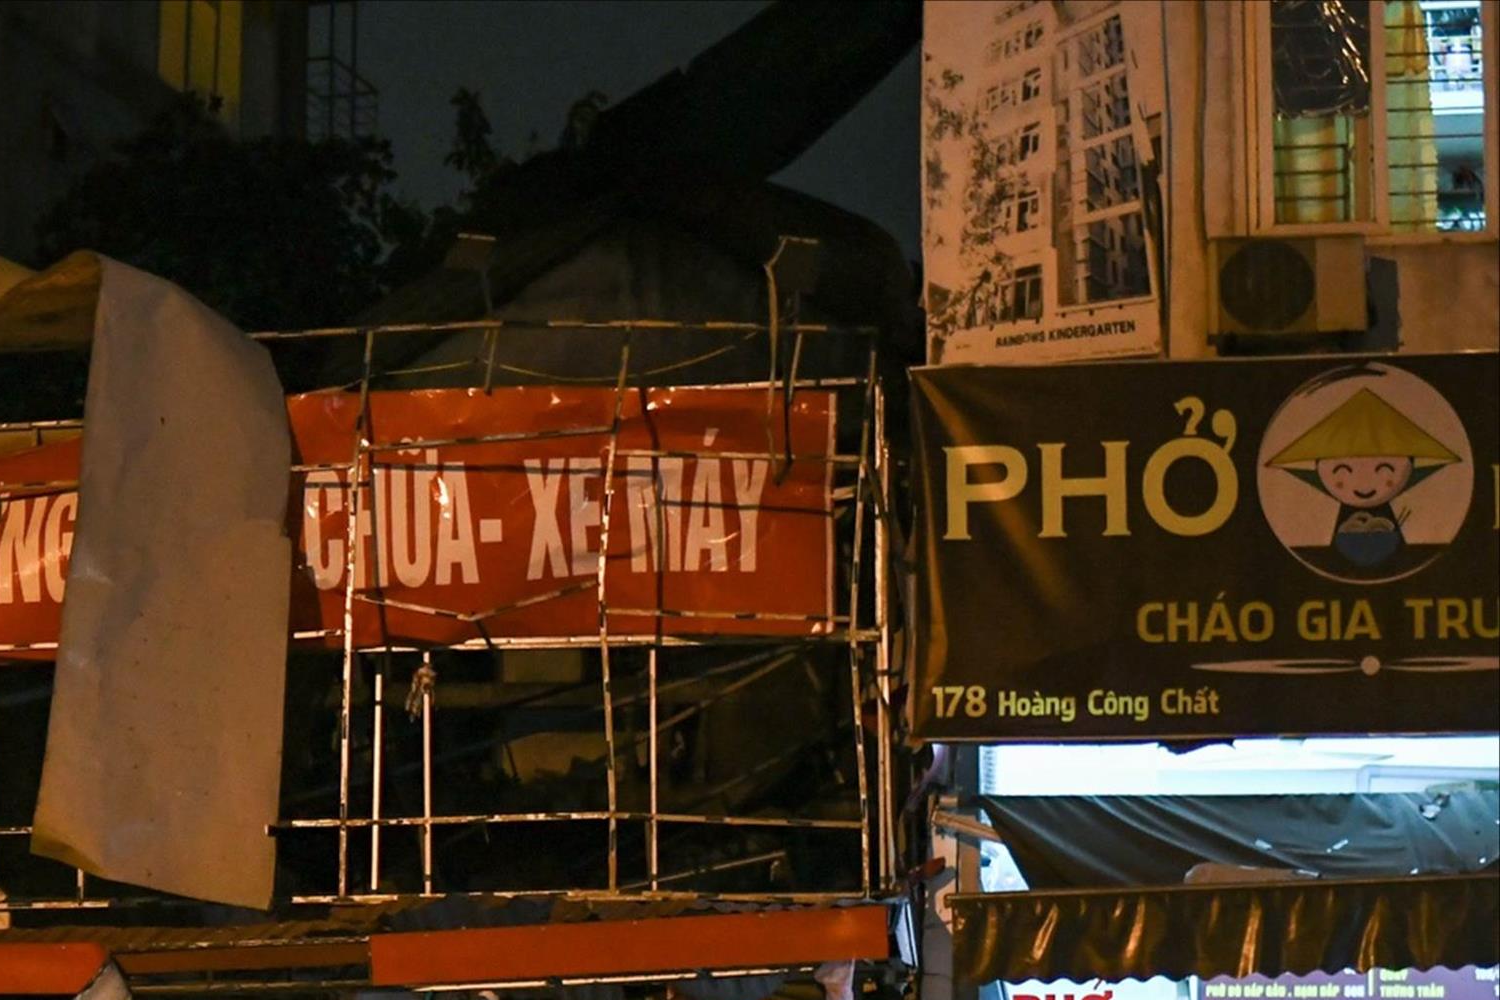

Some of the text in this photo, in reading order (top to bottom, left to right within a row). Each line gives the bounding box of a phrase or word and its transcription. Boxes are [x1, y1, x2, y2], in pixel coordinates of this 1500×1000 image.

[1049, 320, 1137, 343] KINDERGARTEN
[941, 396, 1239, 538] PHỞ
[523, 456, 603, 582] XE
[626, 427, 770, 574] MÁY
[1136, 591, 1275, 643] CHÁO
[1297, 598, 1383, 642] GIA
[931, 685, 1220, 722] 178 Hoàng Công Chất
